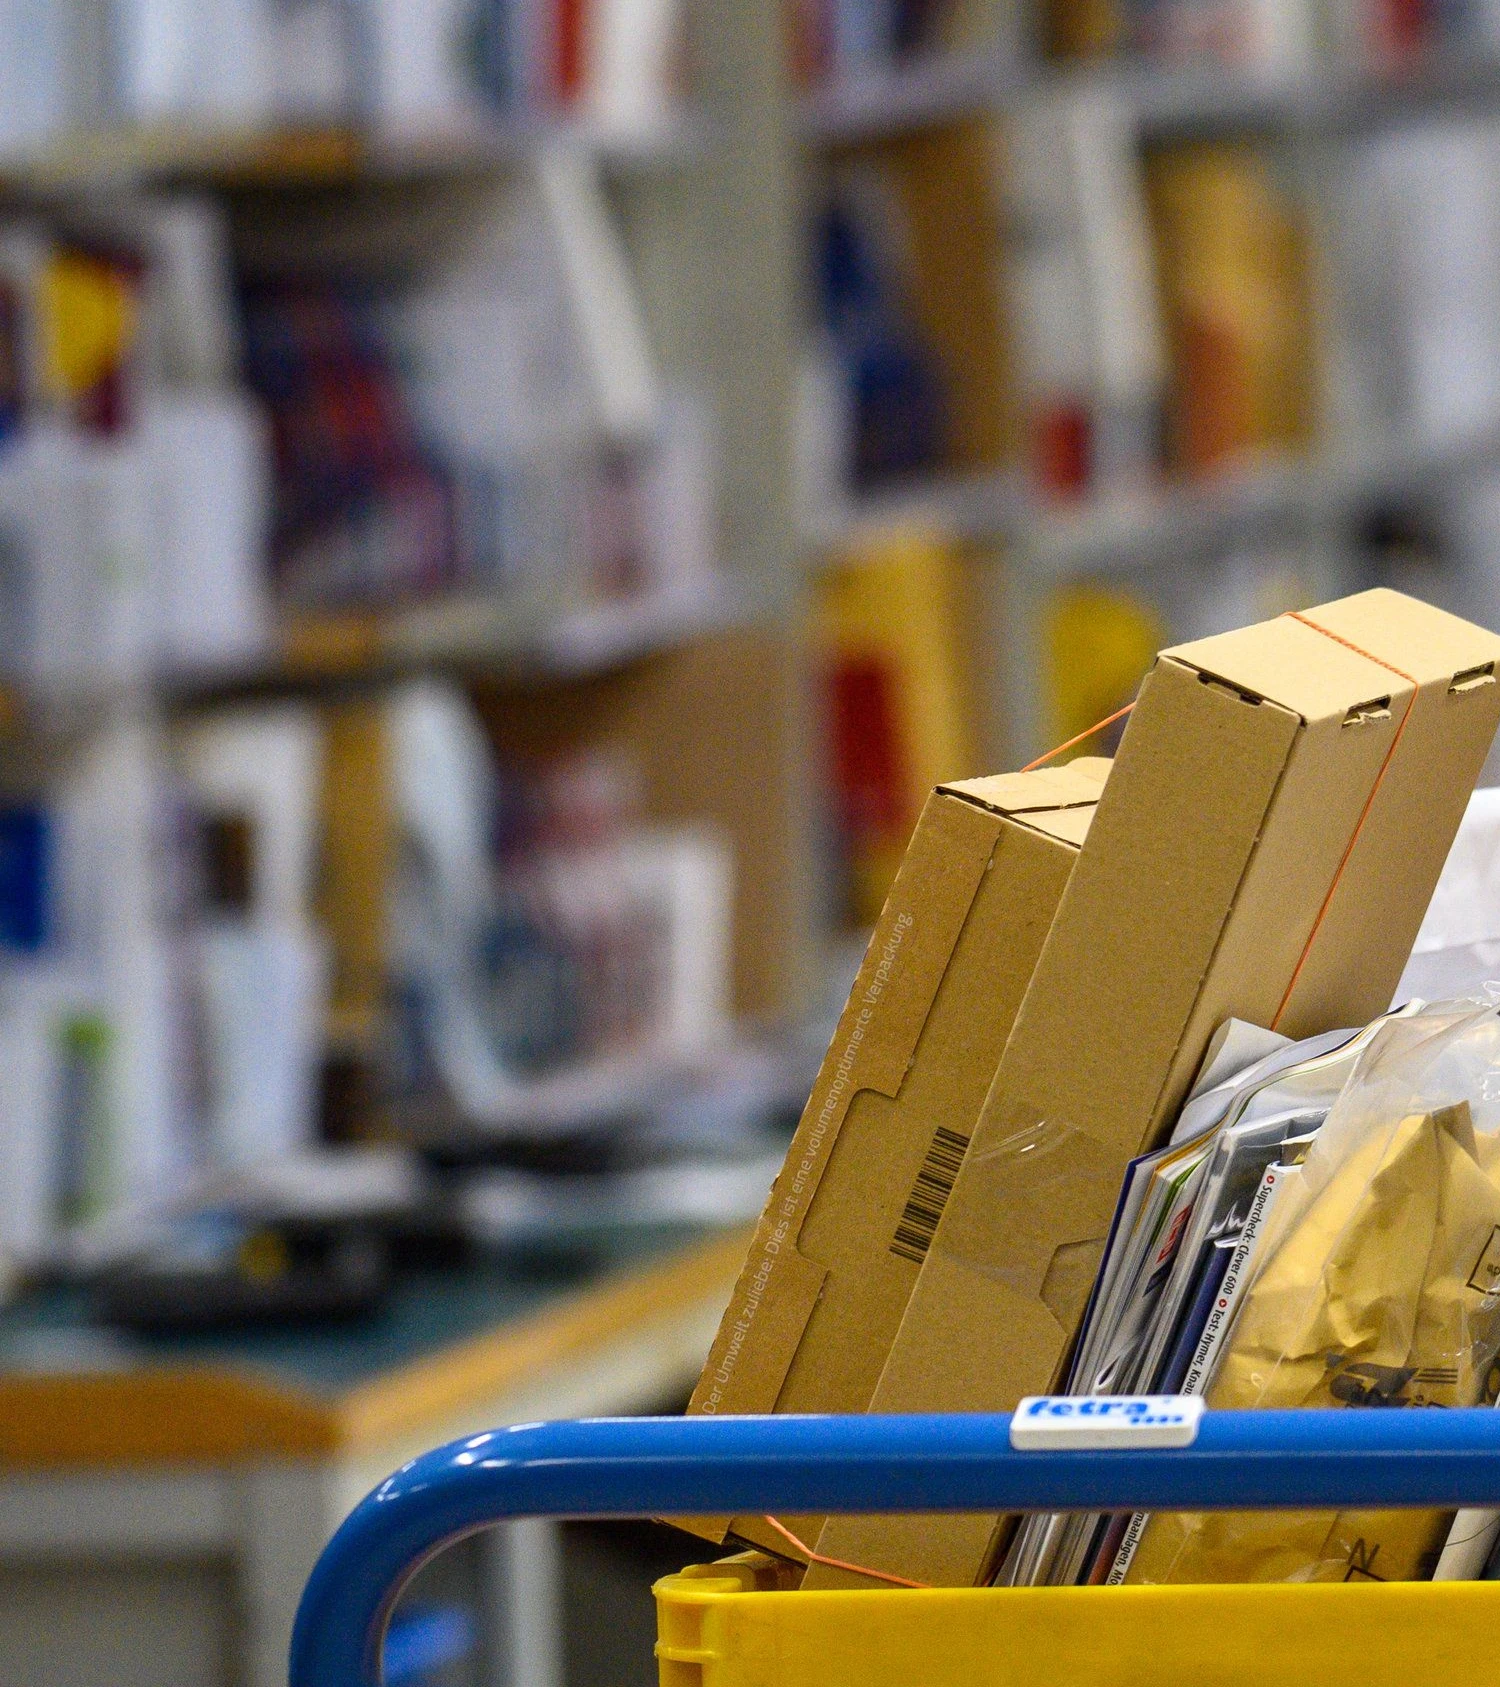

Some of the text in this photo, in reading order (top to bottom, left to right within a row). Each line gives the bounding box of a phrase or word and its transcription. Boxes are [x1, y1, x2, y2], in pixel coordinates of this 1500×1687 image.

[702, 1381, 723, 1415] Der
[713, 1319, 750, 1384] Umwelt
[743, 1255, 775, 1319] zuliebe:
[765, 1217, 789, 1256] Dies
[780, 1196, 799, 1219] ist
[792, 1160, 812, 1195] eine
[808, 1007, 874, 1159] volumenoptimierte
[1182, 1184, 1273, 1397] Supercheck: Clever 600 Test: Hymer, Knau
